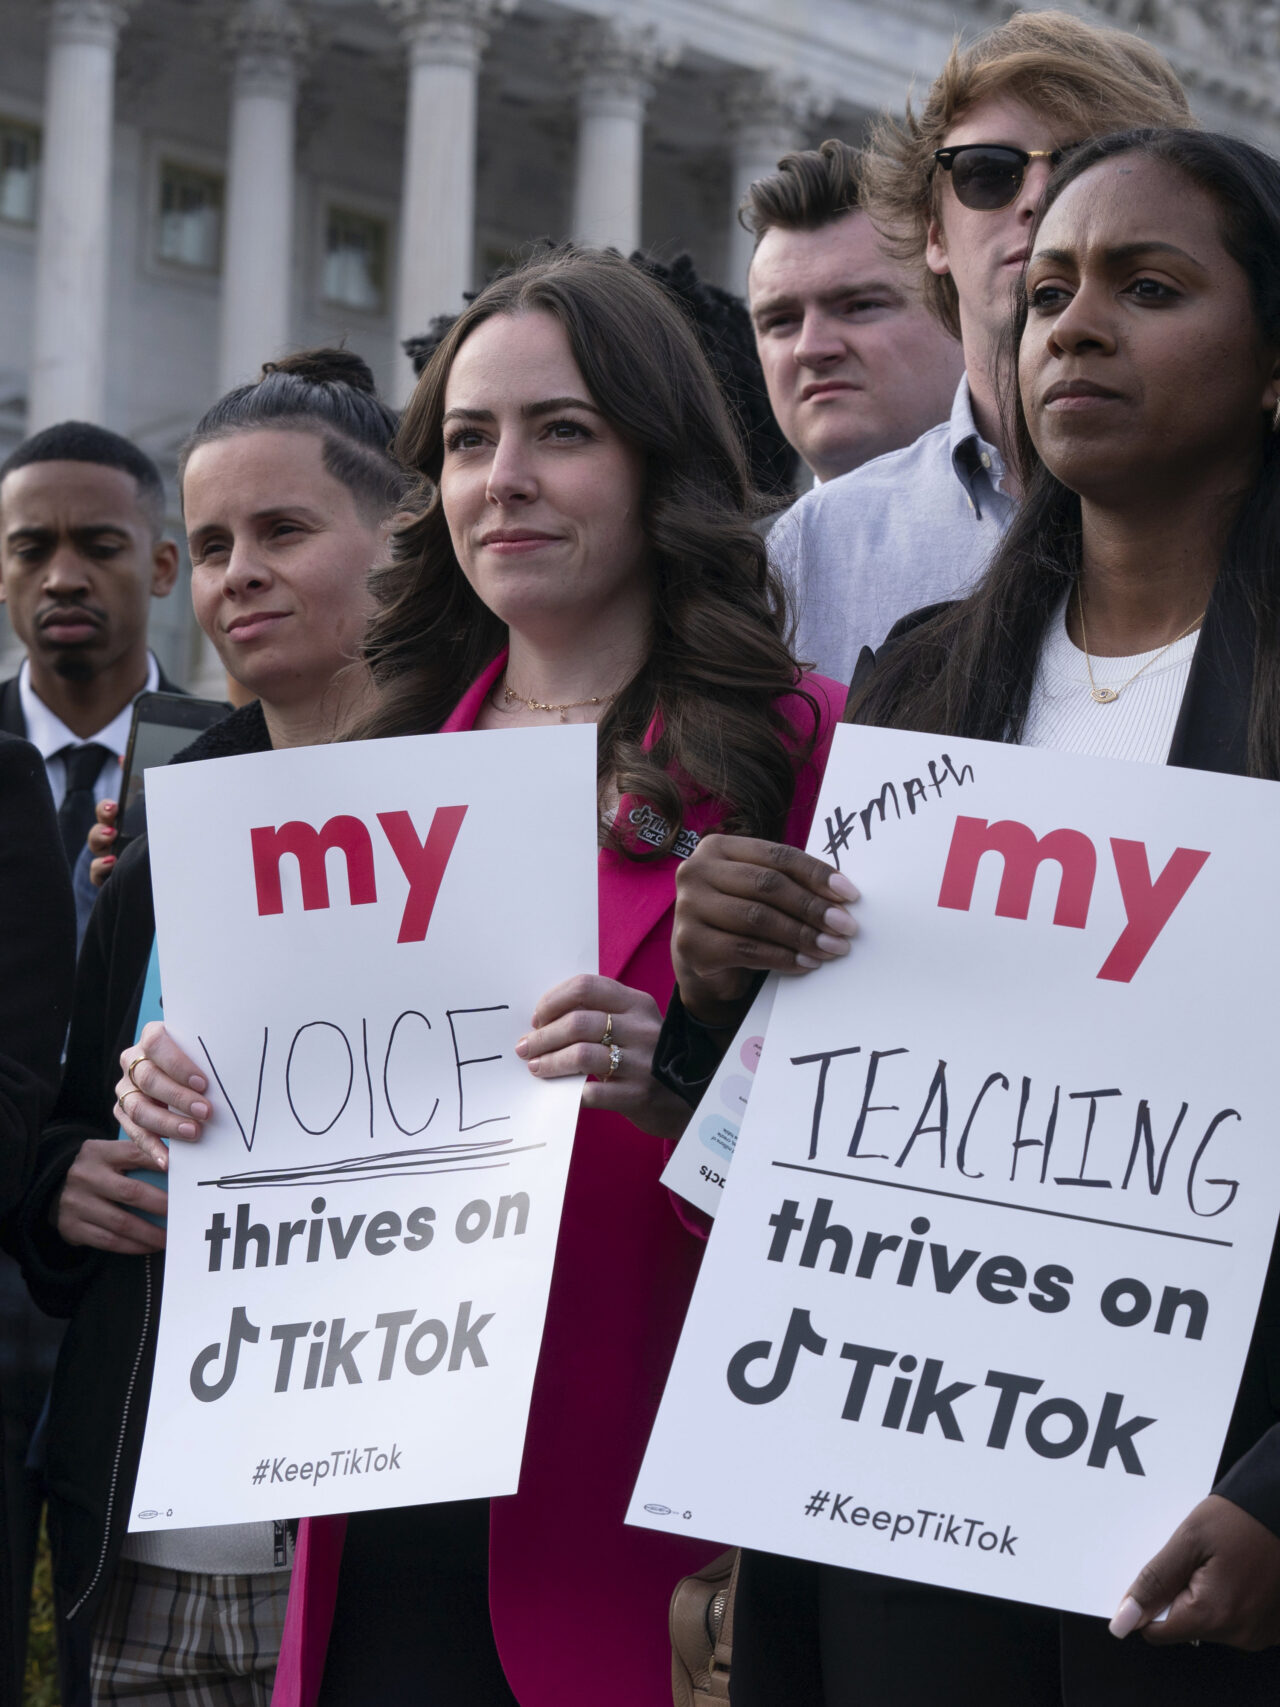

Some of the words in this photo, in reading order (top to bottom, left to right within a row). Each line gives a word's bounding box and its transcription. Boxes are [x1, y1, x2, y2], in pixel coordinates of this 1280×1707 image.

[250, 805, 468, 944] my
[642, 828, 656, 840] for
[937, 816, 1211, 983] my
[198, 1005, 511, 1153] VOICE
[790, 1045, 1242, 1218] TEACHING
[205, 1197, 436, 1272] thrives
[455, 1192, 529, 1244] on
[699, 1165, 727, 1189] acts
[767, 1198, 1074, 1313] thrives
[1100, 1278, 1209, 1341] on
[270, 1301, 495, 1393] TikTok
[252, 1443, 402, 1487] #KeepTikTok
[840, 1342, 1158, 1477] TikTok
[804, 1489, 1019, 1557] #KeepTikTok
